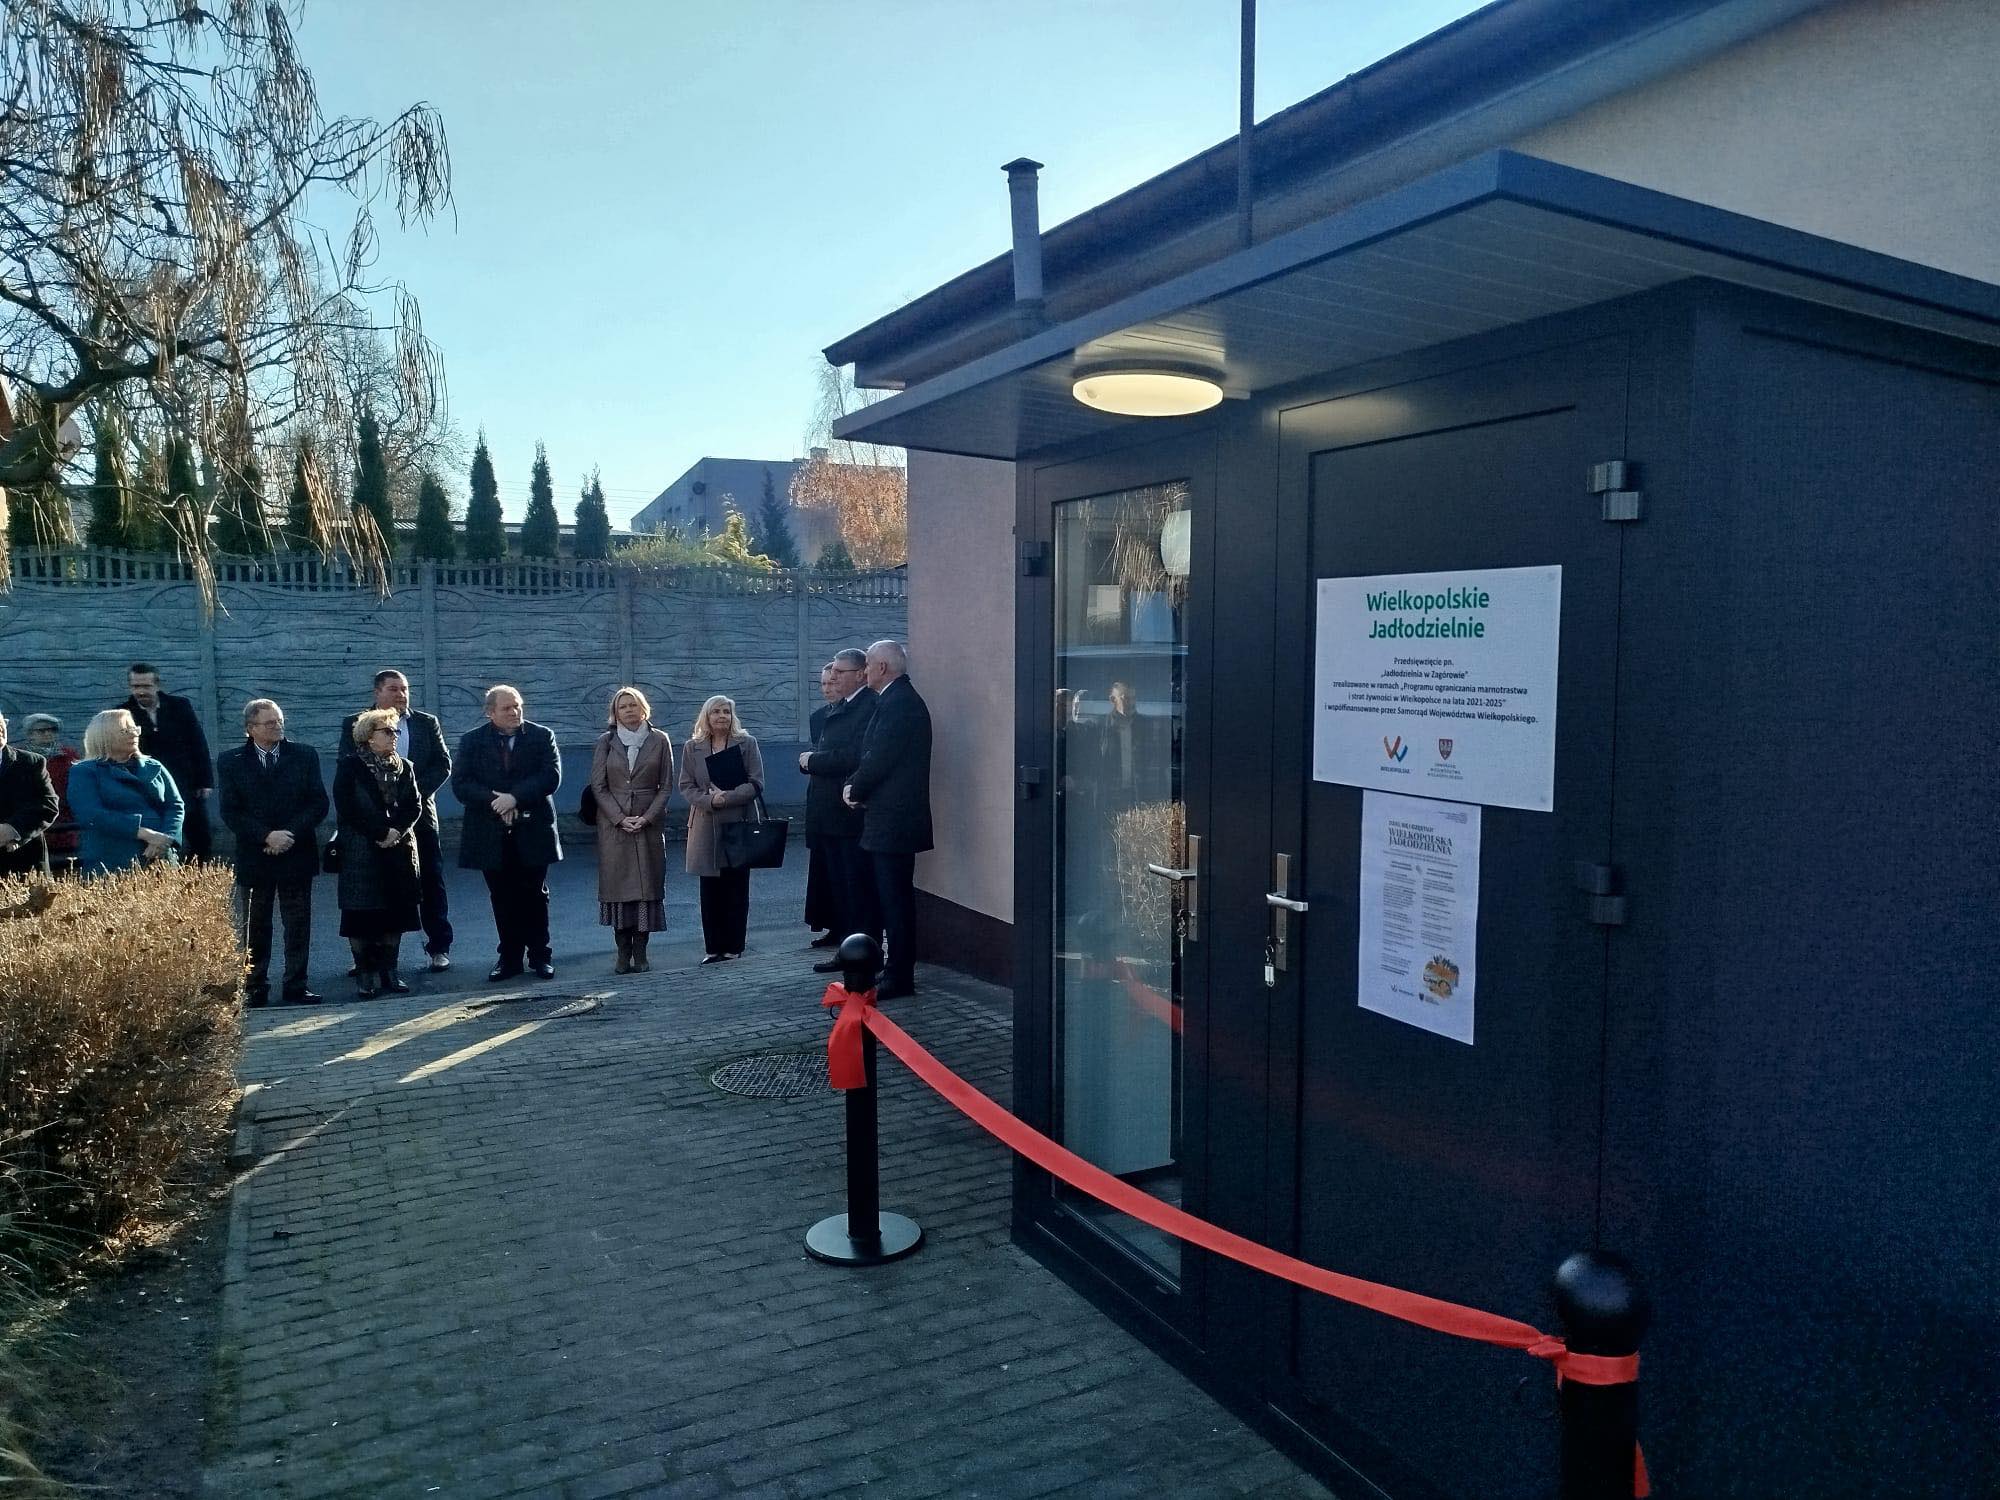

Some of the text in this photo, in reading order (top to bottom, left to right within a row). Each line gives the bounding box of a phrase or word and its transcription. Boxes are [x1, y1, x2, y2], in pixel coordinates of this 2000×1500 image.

[1367, 586, 1490, 615] Wielkopolskie
[1369, 616, 1485, 639] Jadłodzielnie
[1394, 657, 1454, 668] Przedsięwzięcie pn.
[1333, 680, 1370, 688] zrealizowane
[1435, 684, 1476, 693] ograniczania
[1366, 693, 1392, 702] żywności
[1400, 695, 1441, 705] Wielkopolsce
[1452, 697, 1464, 705] lata
[1328, 704, 1379, 714] współfinansowane
[1380, 707, 1396, 715] przez
[1397, 706, 1428, 717] Samorząd
[1429, 708, 1476, 719] Województwa
[1477, 711, 1539, 725] Wielkopolskiego.
[1388, 827, 1452, 847] WIELKOPOLSKA
[1389, 836, 1452, 856] JADŁODZIELNIA
